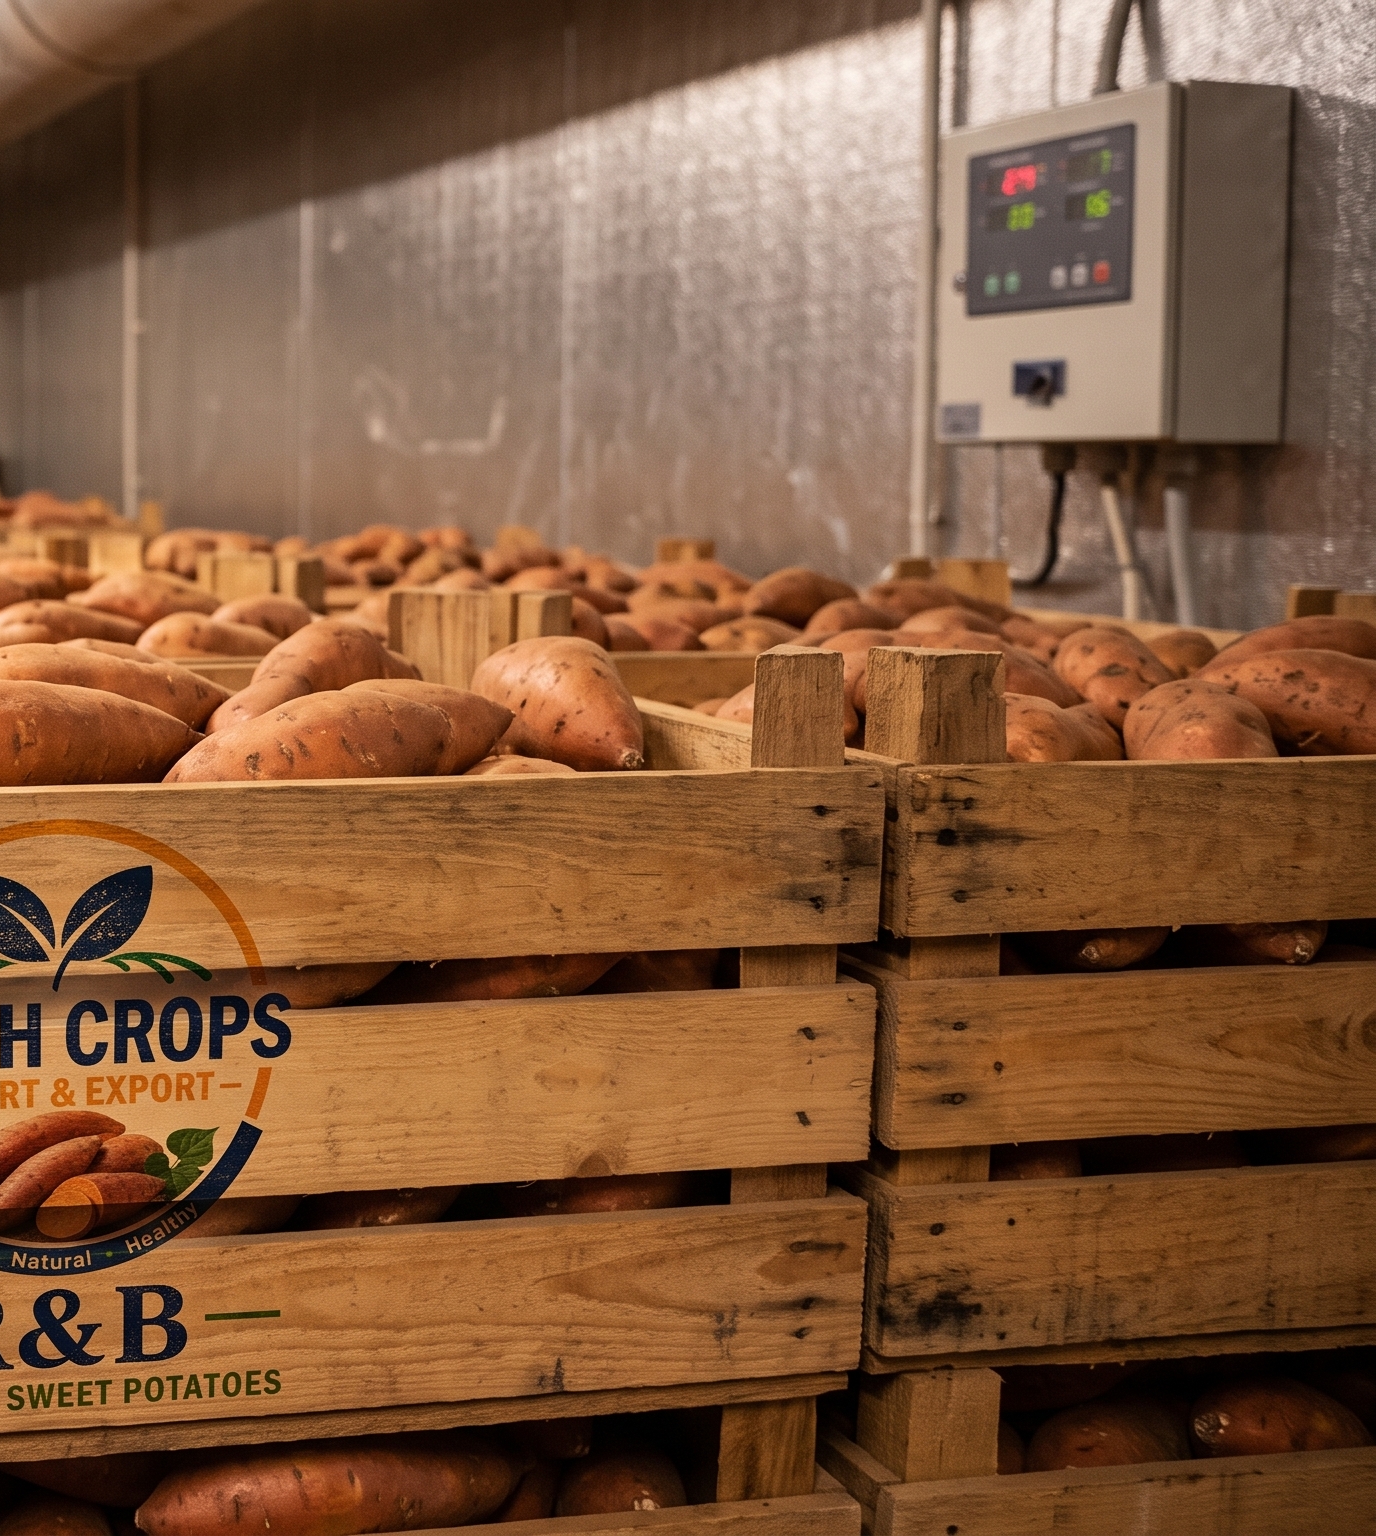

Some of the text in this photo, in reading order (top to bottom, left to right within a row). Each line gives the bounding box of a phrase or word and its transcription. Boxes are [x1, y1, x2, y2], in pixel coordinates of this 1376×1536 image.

[65, 992, 292, 1067] CROPS
[50, 1077, 76, 1108] &
[86, 1071, 215, 1106] EXPORT
[11, 1250, 93, 1271] Natural
[124, 1201, 199, 1254] Healthy
[6, 1379, 112, 1411] SWEET
[124, 1369, 282, 1404] POTATOES
